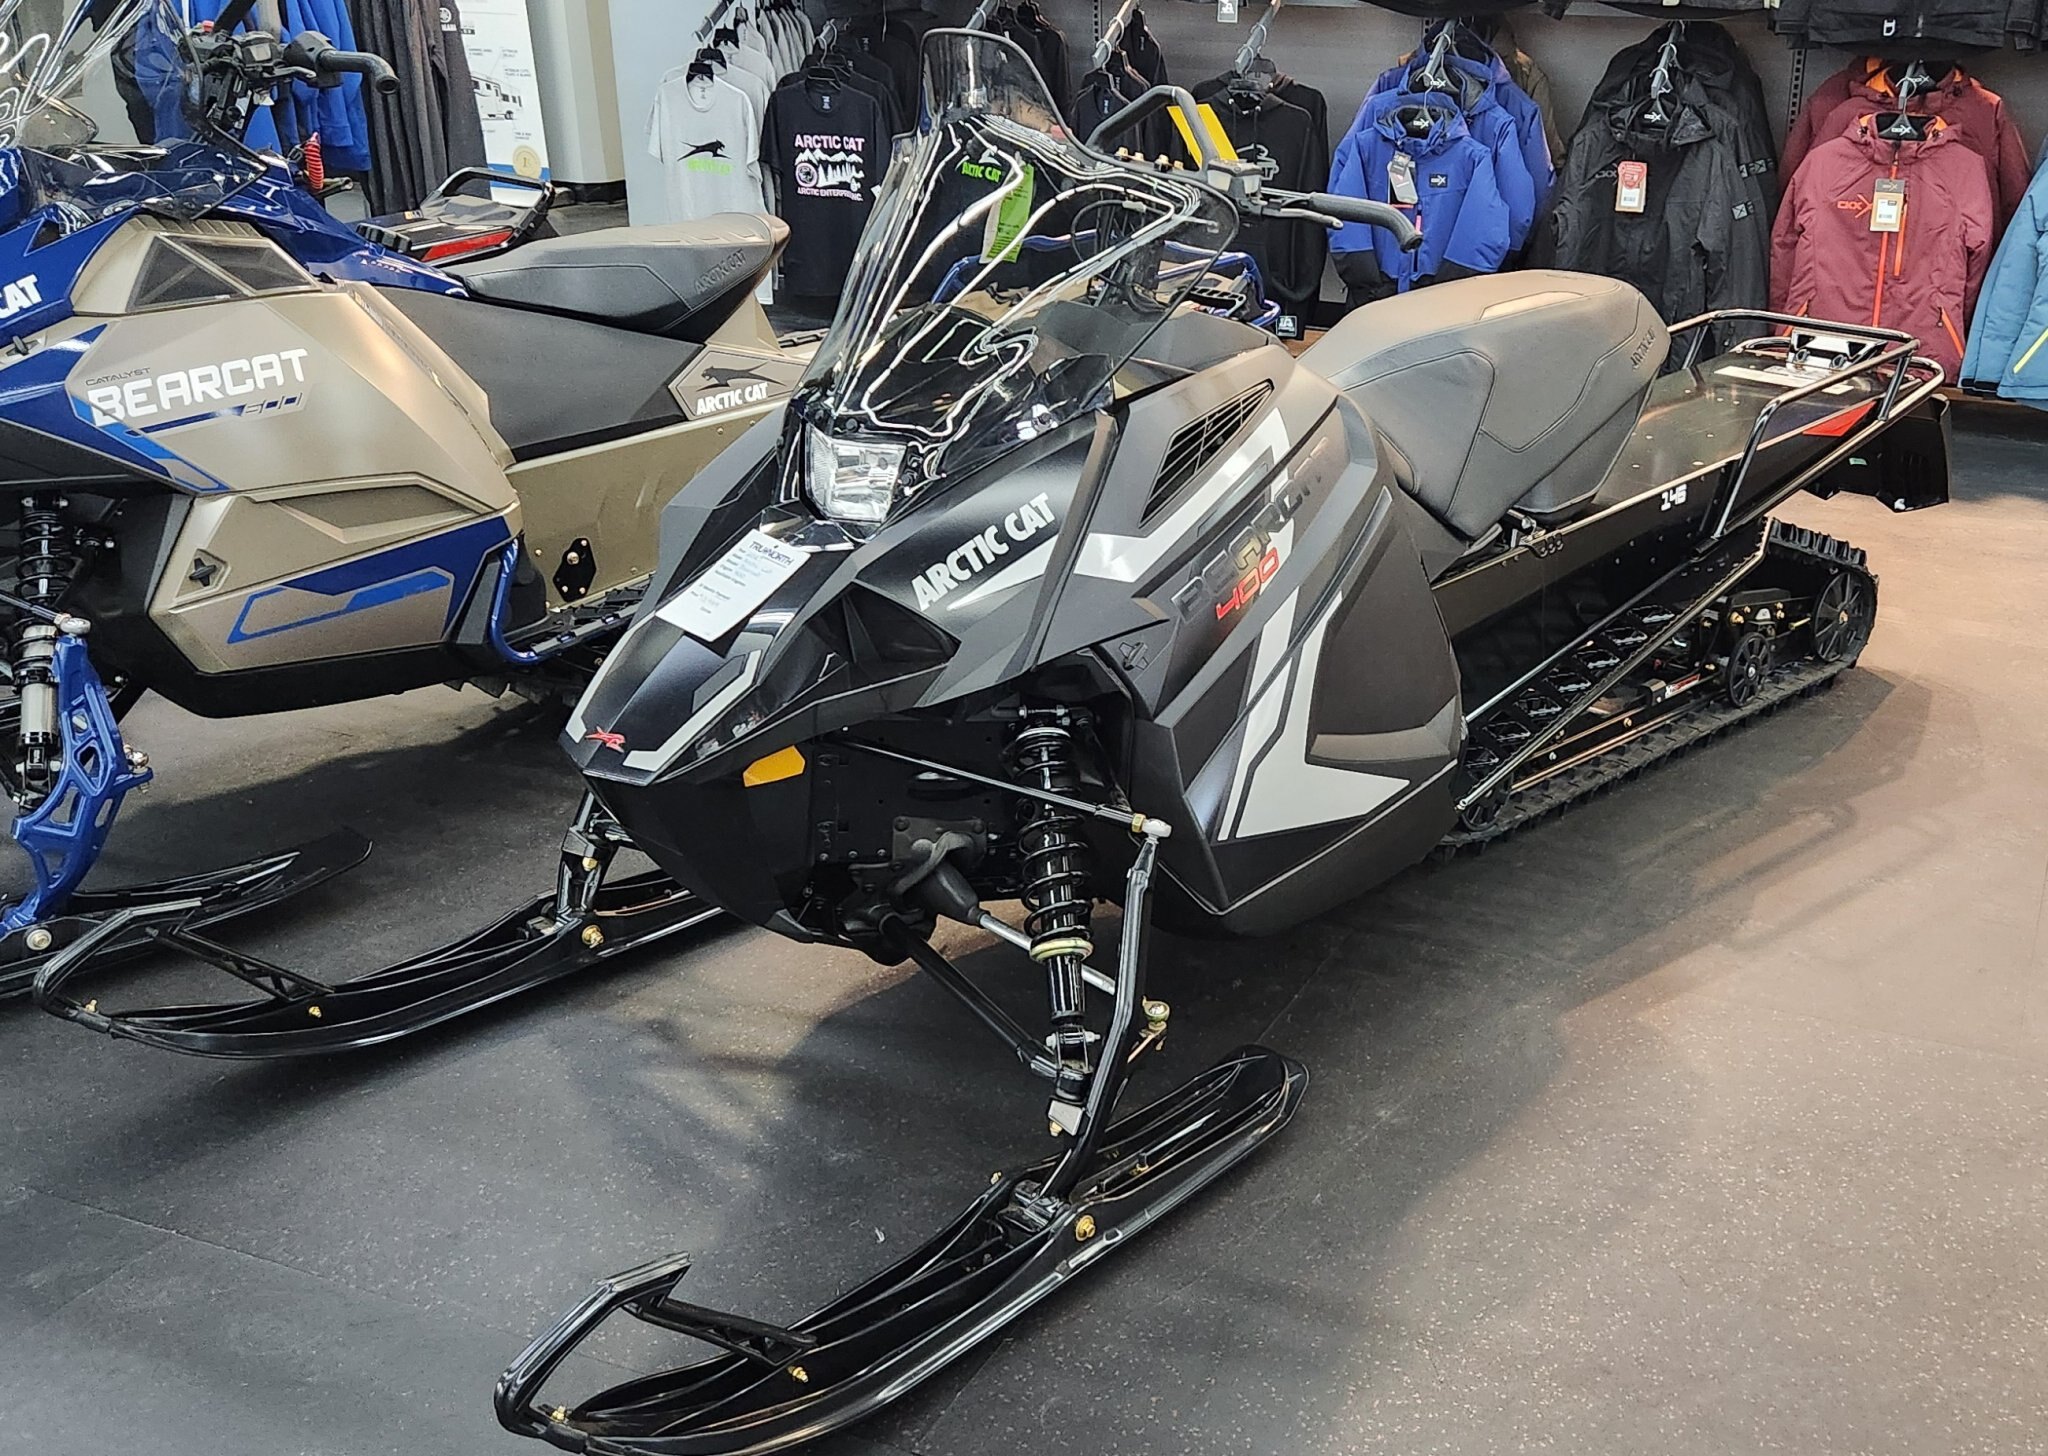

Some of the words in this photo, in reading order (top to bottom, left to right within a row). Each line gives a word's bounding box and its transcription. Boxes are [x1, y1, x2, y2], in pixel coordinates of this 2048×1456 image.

[795, 134, 842, 149] ARCTIC
[843, 136, 865, 151] CAT
[85, 367, 151, 386] CATALYST
[87, 348, 308, 427] BEARCAT
[696, 390, 743, 416] ARCTIC
[744, 382, 768, 401] CAT
[911, 525, 1010, 611] ARCTIC
[1004, 492, 1055, 541] CAT
[1216, 547, 1280, 620] 400
